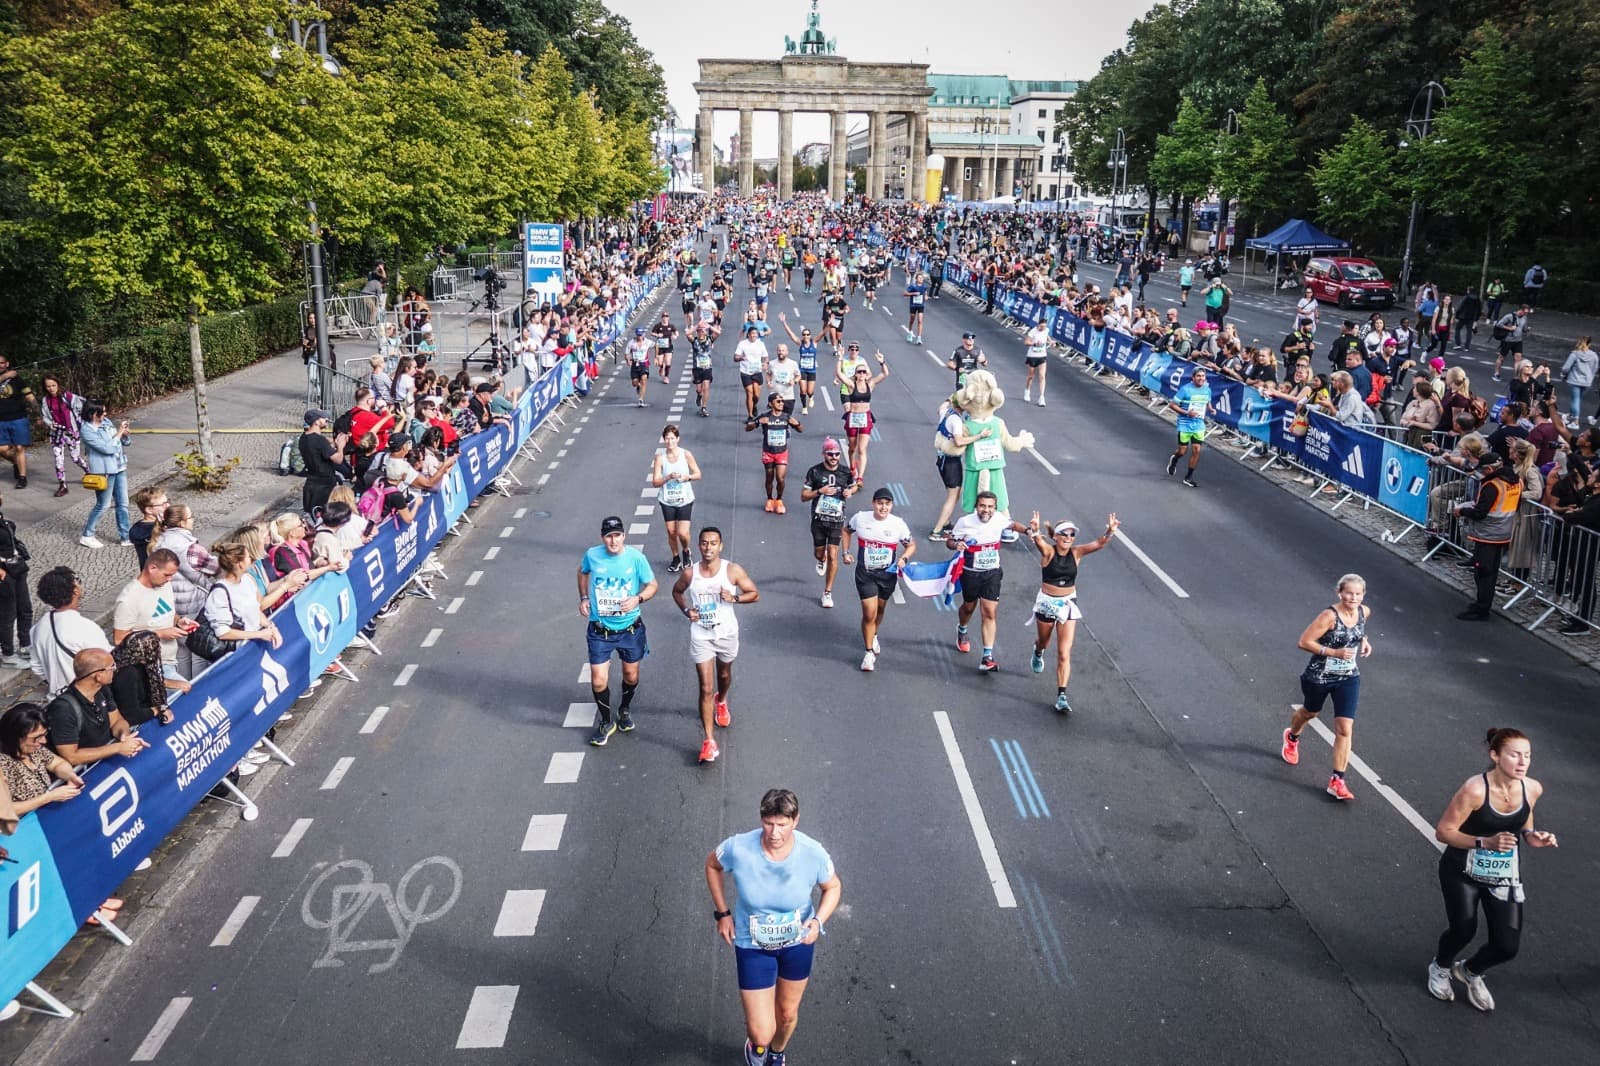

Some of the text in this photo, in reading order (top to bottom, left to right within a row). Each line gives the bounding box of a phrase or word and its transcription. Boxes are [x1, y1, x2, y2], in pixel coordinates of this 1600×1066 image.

[530, 255, 560, 264] km 42
[1305, 444, 1329, 462] MARATHON
[166, 713, 208, 758] BMW
[176, 733, 213, 774] BERLIN
[176, 733, 230, 791] MARATHON
[111, 817, 145, 858] Abbott
[1476, 859, 1510, 868] 63076
[760, 924, 792, 935] 39106
